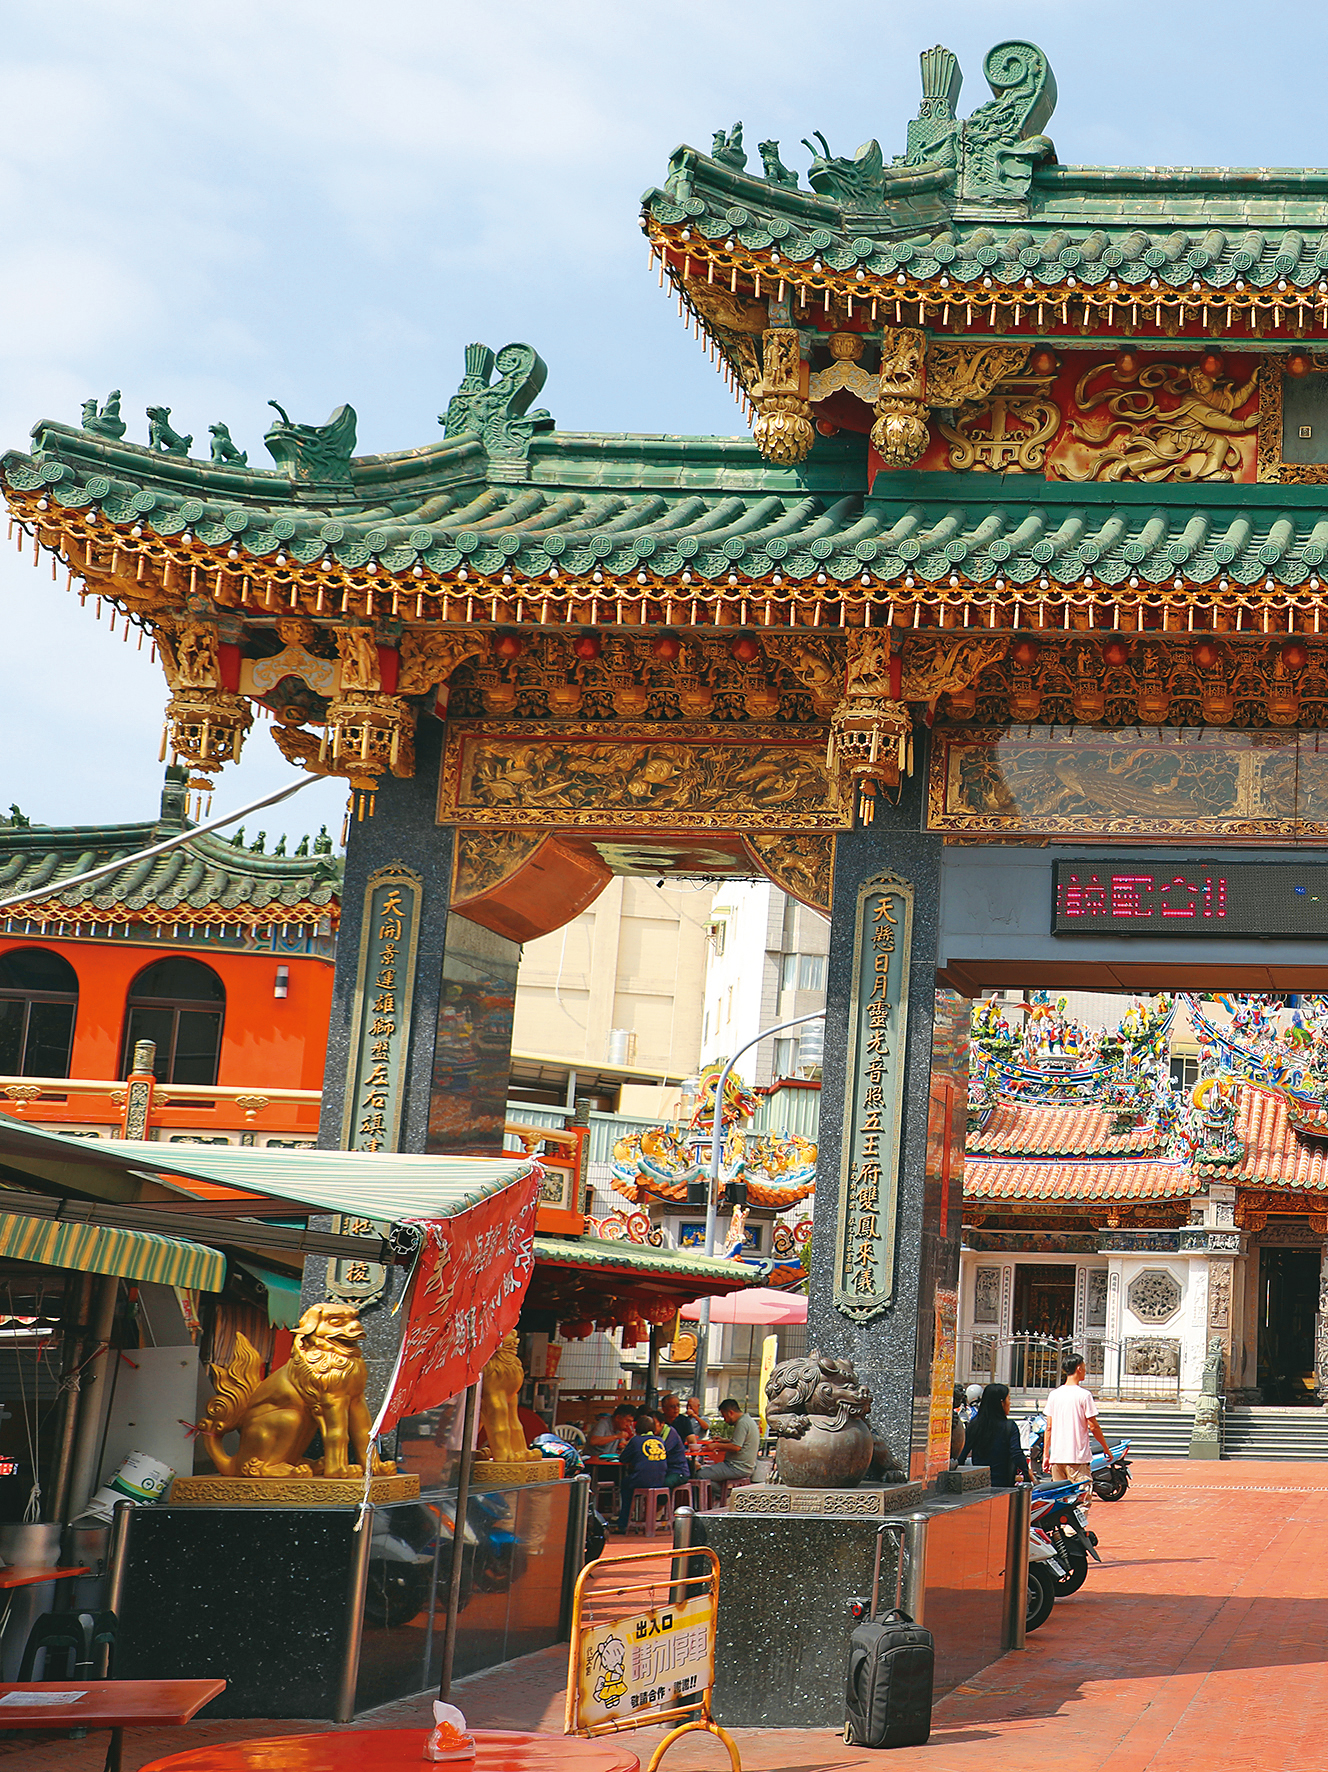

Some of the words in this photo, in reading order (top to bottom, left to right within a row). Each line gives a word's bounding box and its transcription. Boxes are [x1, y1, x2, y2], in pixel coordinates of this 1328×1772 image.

[636, 1614, 673, 1639] 出入口
[631, 1627, 708, 1687] 請勿停車
